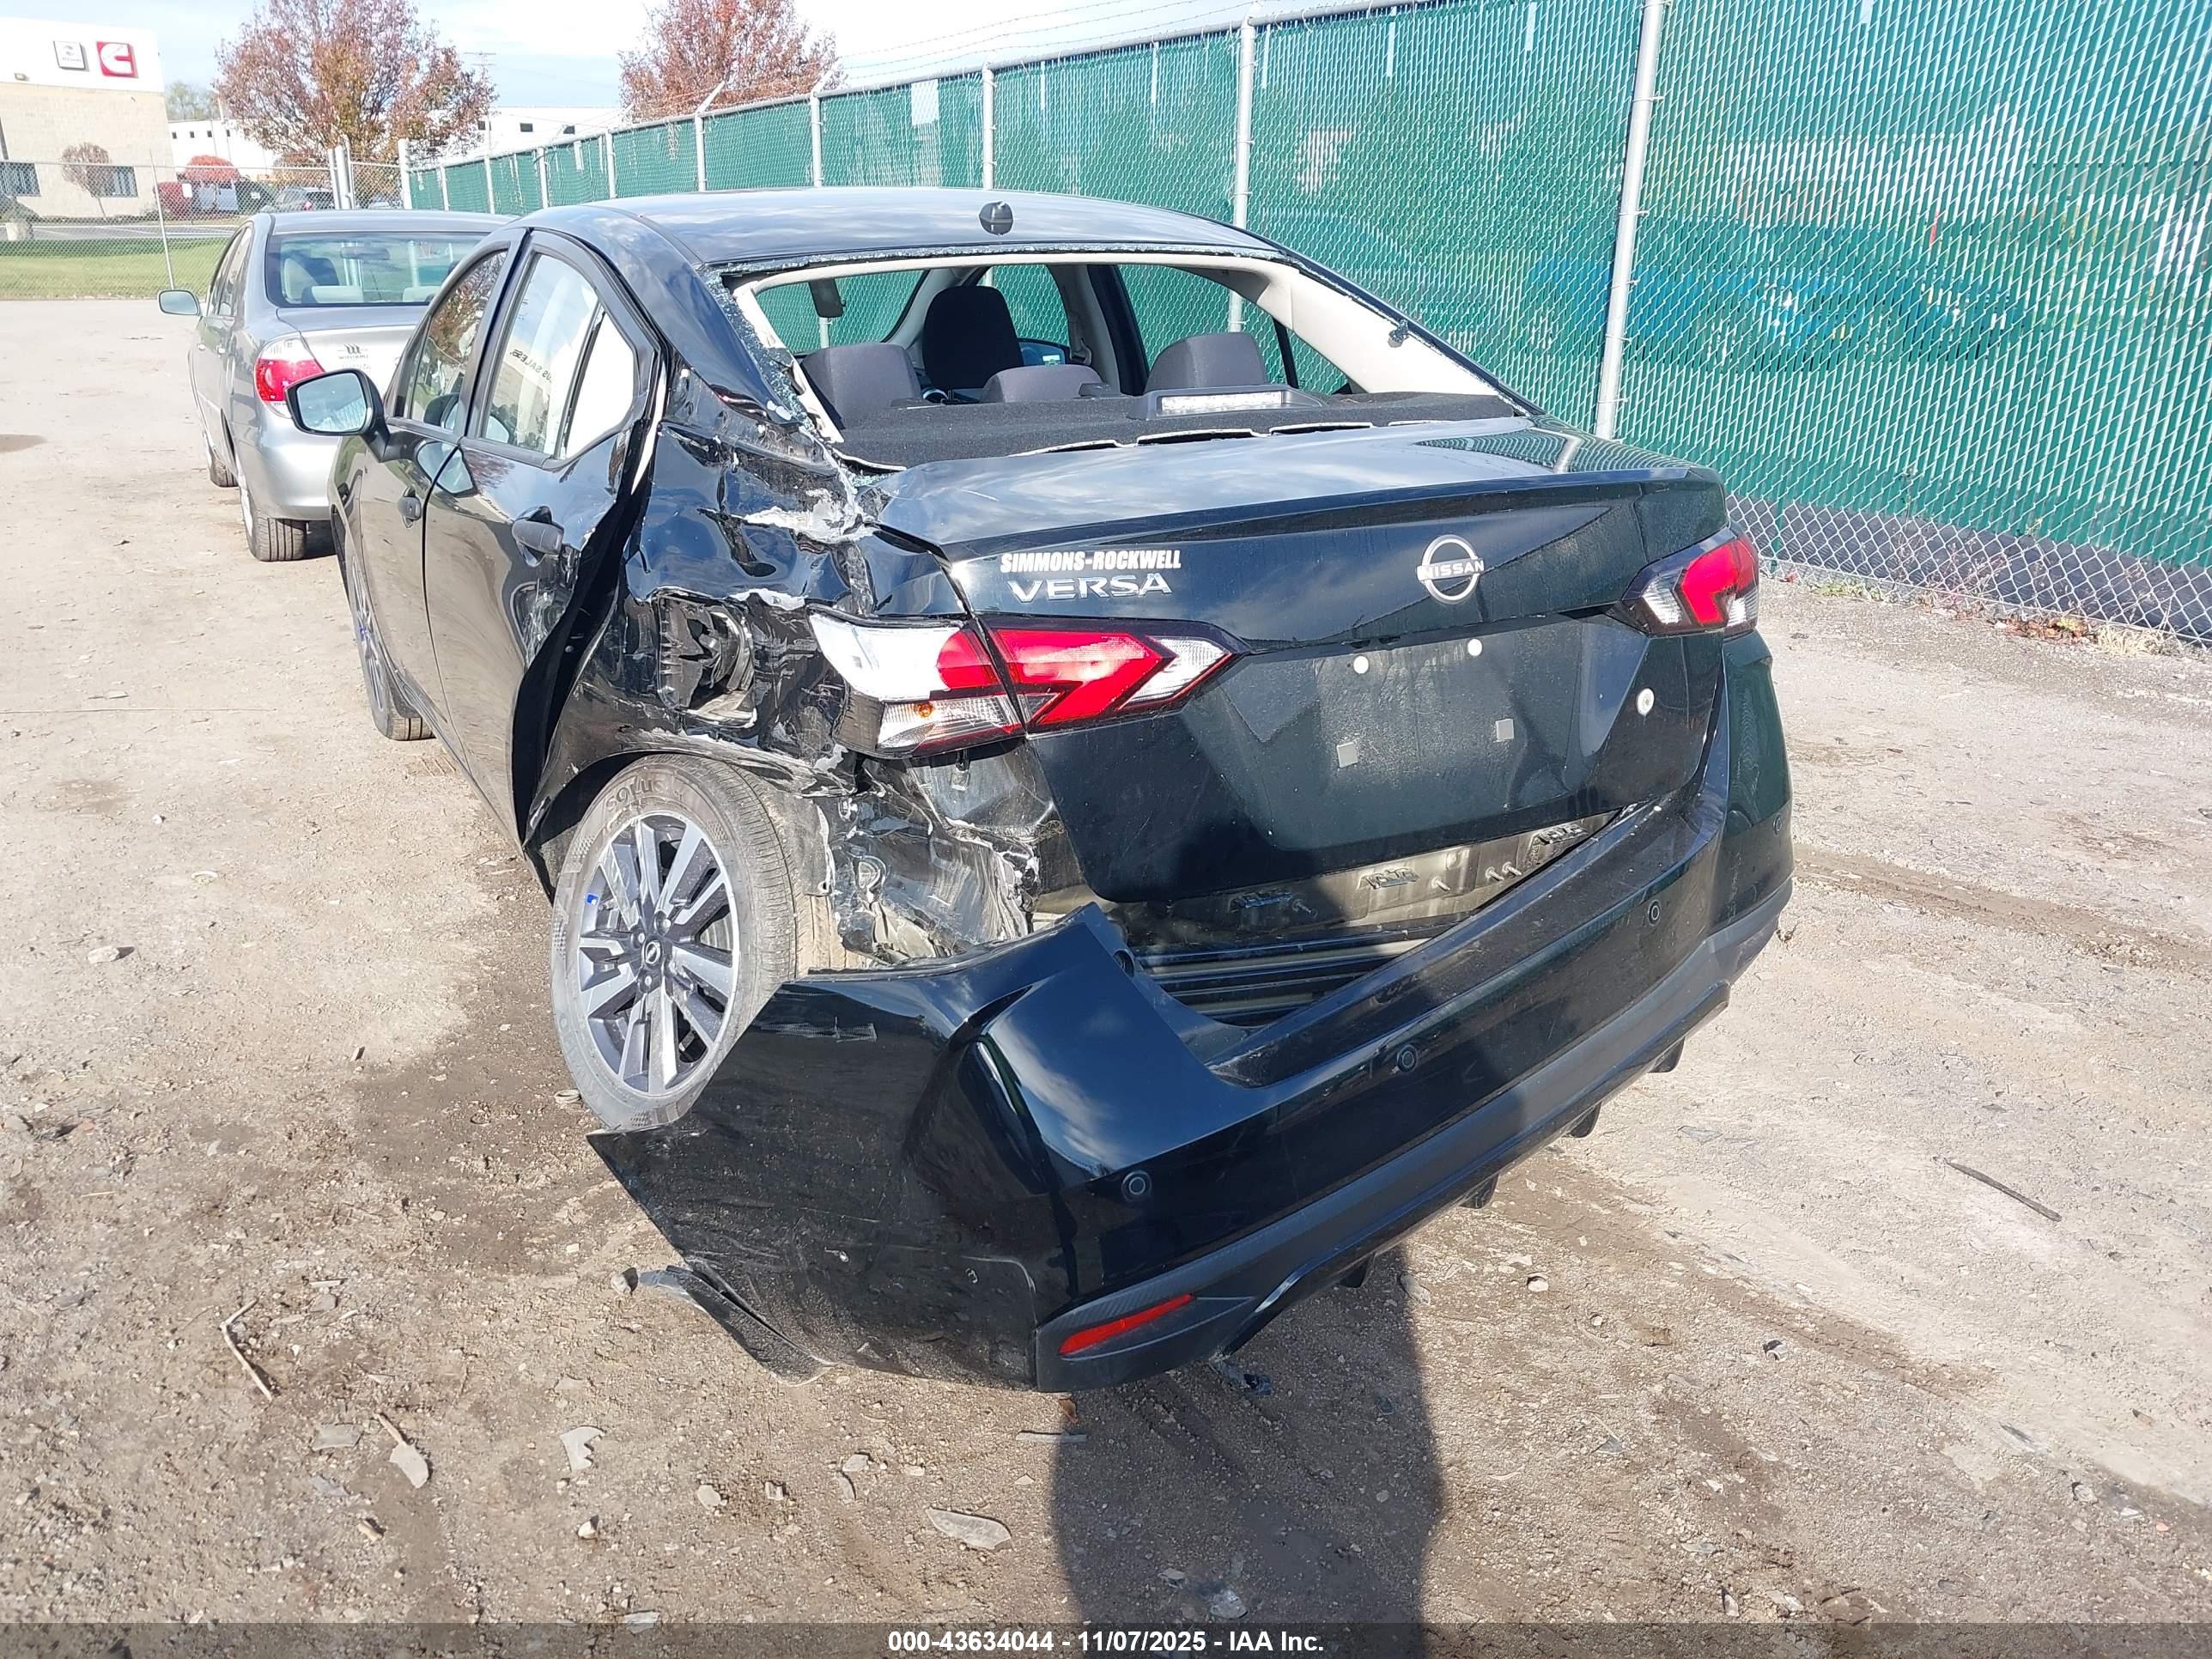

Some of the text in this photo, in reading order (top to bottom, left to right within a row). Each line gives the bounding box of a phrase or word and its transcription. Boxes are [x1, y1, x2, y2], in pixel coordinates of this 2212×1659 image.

[1000, 550, 1182, 573] SIMMONS-ROCKWELL
[1420, 560, 1485, 579] NISSAN
[1007, 573, 1172, 603] VERSA
